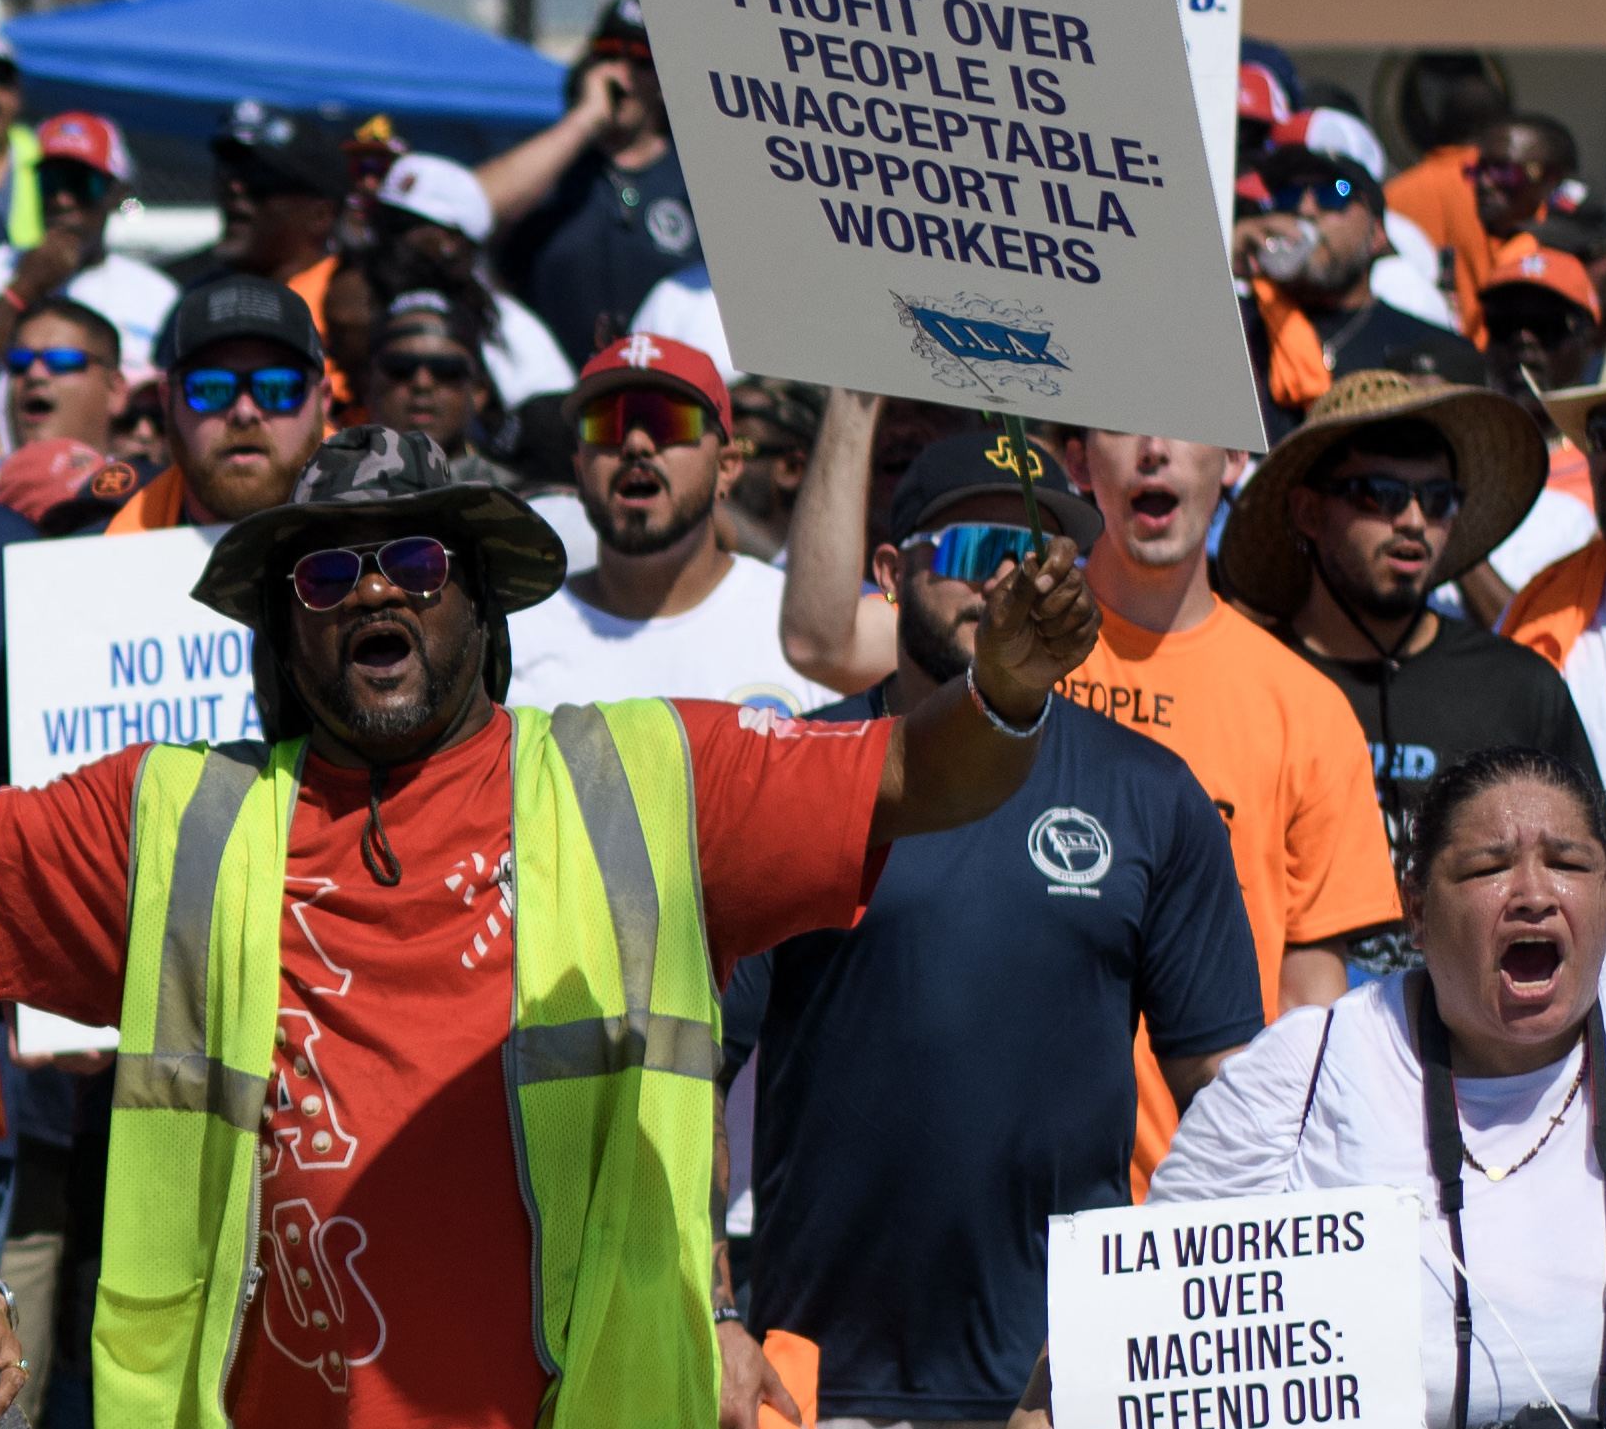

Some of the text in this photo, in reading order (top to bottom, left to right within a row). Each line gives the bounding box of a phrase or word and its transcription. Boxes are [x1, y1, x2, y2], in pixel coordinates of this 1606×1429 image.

[779, 26, 1067, 117] PEOPLE IS
[708, 70, 1165, 189] UNACCEPTABLE:
[764, 134, 1138, 239] SUPPORT ILA
[819, 197, 1102, 285] WORKERS
[934, 320, 1049, 361] I.L.A.
[109, 639, 163, 689] NO
[42, 696, 224, 757] WITHOUT
[1101, 1210, 1365, 1276] ILA WORKERS
[1182, 1269, 1285, 1322] OVER
[1126, 1319, 1346, 1384] MACHINES:
[1281, 1373, 1361, 1426] OUR
